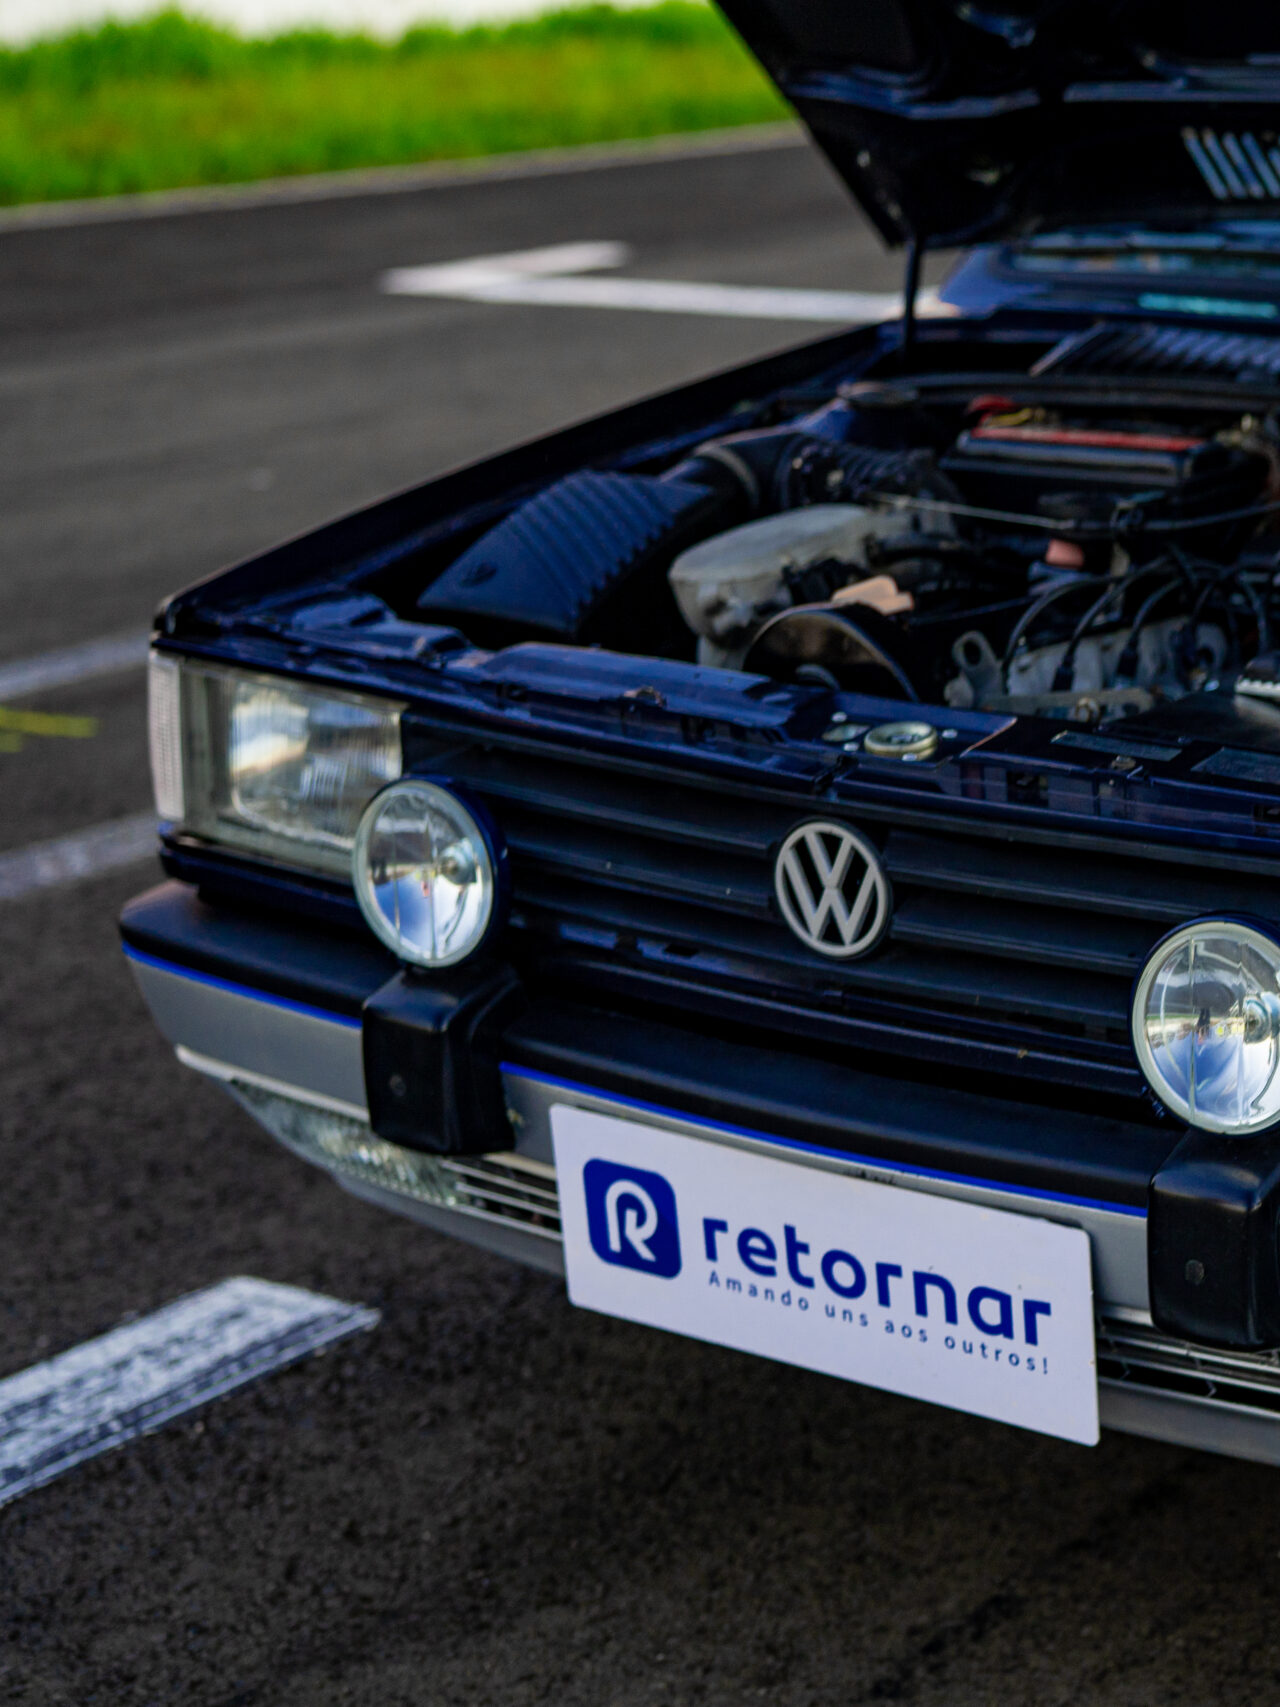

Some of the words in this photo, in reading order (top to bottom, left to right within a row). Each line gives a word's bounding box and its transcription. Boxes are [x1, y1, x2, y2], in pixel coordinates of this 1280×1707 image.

[775, 822, 888, 956] VW
[701, 1216, 1053, 1347] retornar
[708, 1270, 809, 1312] Amando
[824, 1303, 869, 1327] uns
[884, 1319, 928, 1343] aos
[943, 1335, 1049, 1375] outros!
